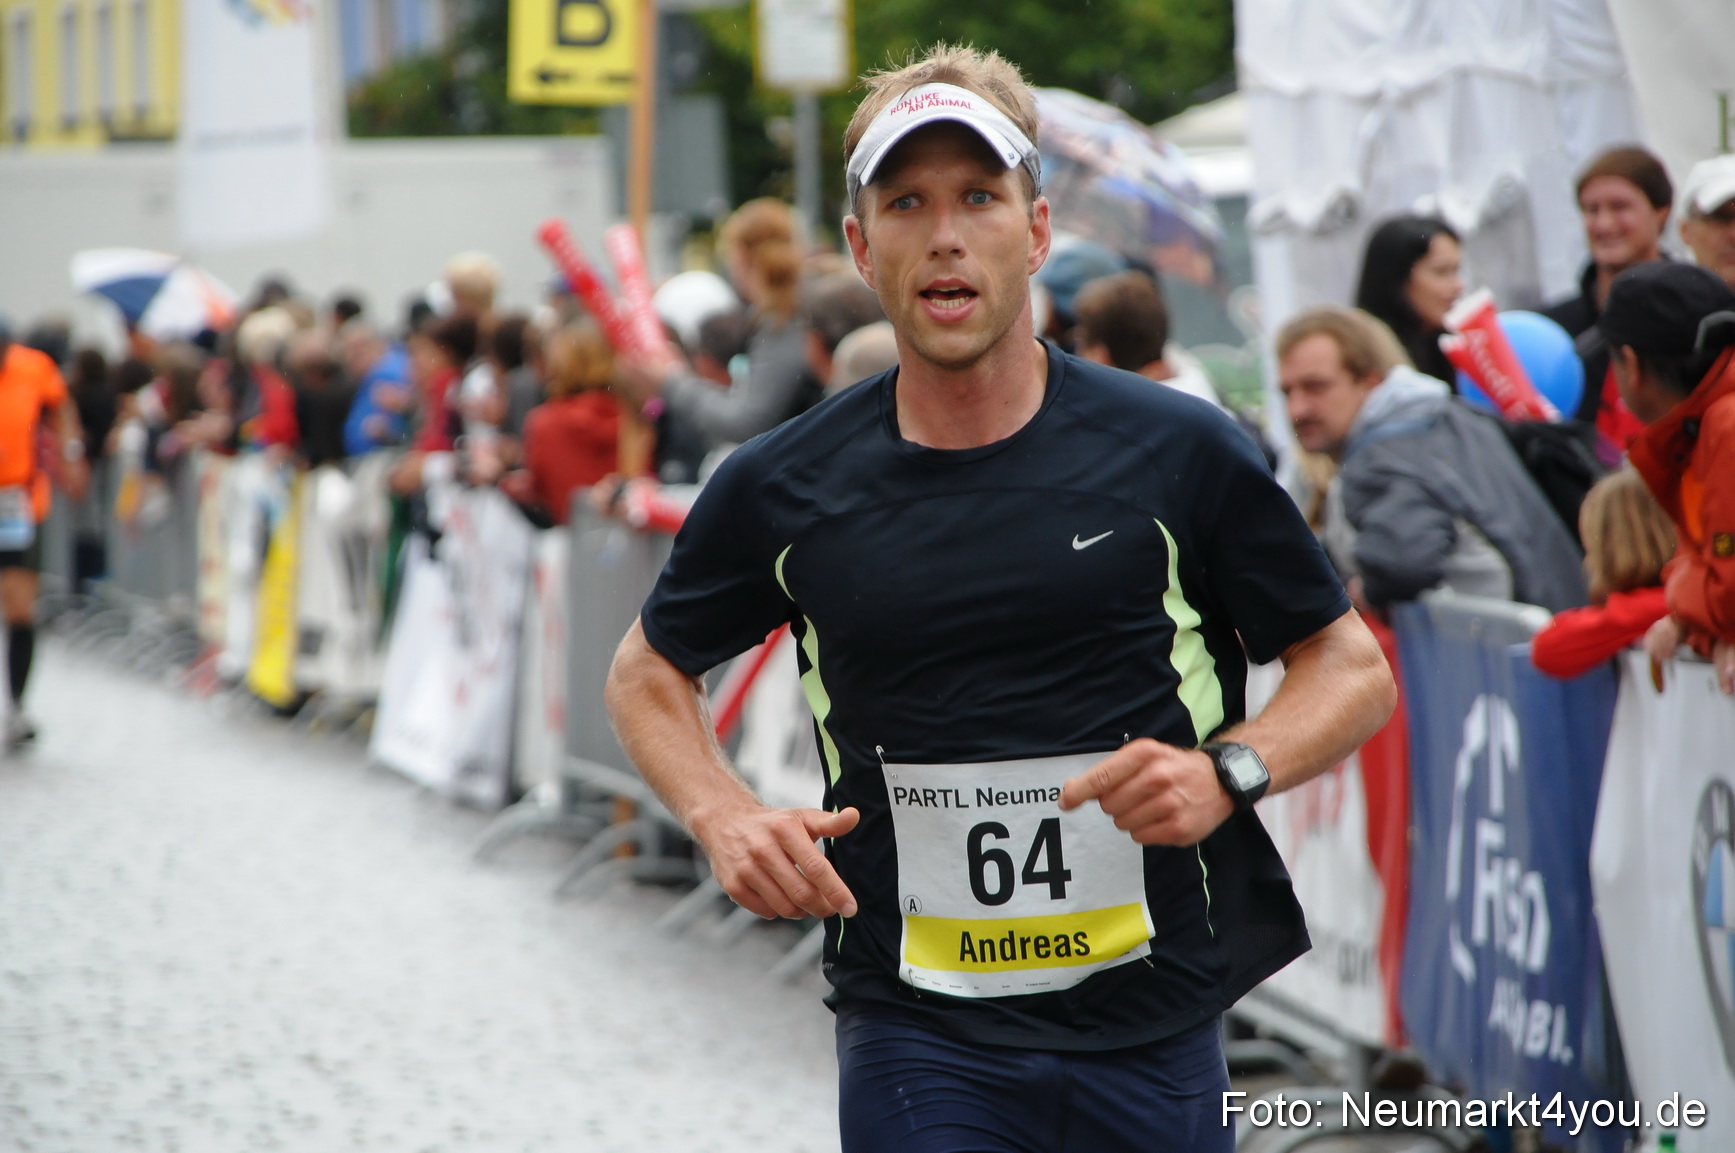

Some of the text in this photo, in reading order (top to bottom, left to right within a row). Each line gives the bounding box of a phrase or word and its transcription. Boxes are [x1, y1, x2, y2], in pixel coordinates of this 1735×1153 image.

[889, 92, 940, 116] RUN LIKE
[907, 99, 975, 115] AN ANIMAL
[893, 786, 1067, 809] PARTL Neuma
[966, 817, 1072, 907] 64
[959, 930, 1091, 963] Andreas
